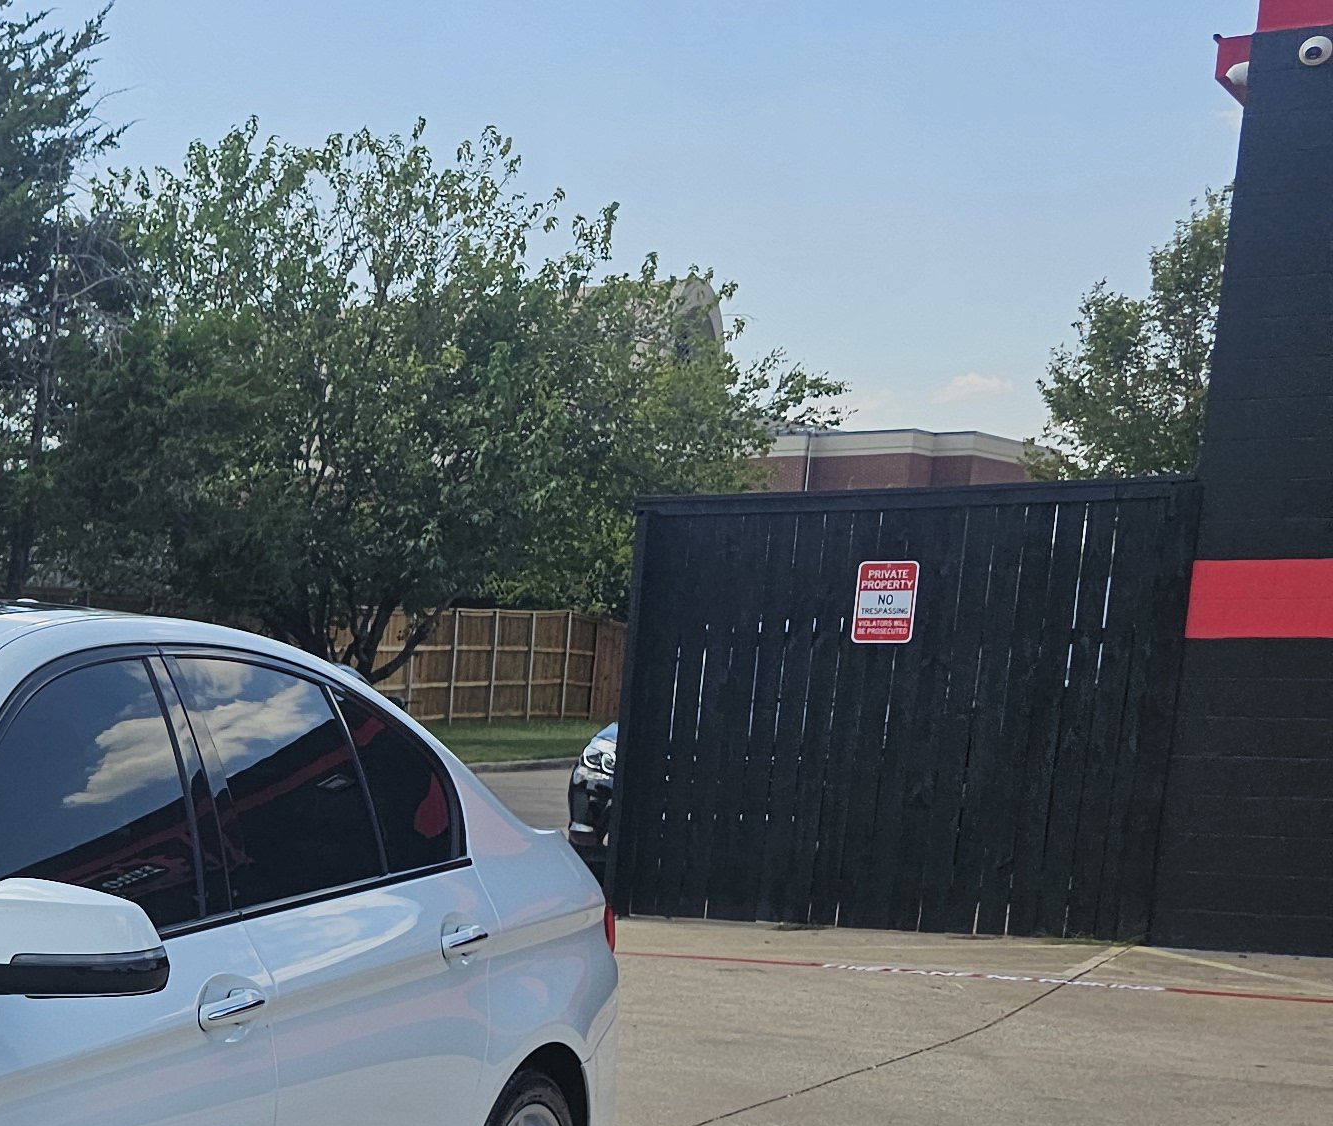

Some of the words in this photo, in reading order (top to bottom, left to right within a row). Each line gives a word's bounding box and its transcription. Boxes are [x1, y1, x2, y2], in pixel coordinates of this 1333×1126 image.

[867, 569, 909, 579] PRIVATE
[861, 580, 913, 589] PROPERTY
[878, 594, 894, 605] NO
[861, 607, 908, 615] TRESPASSING
